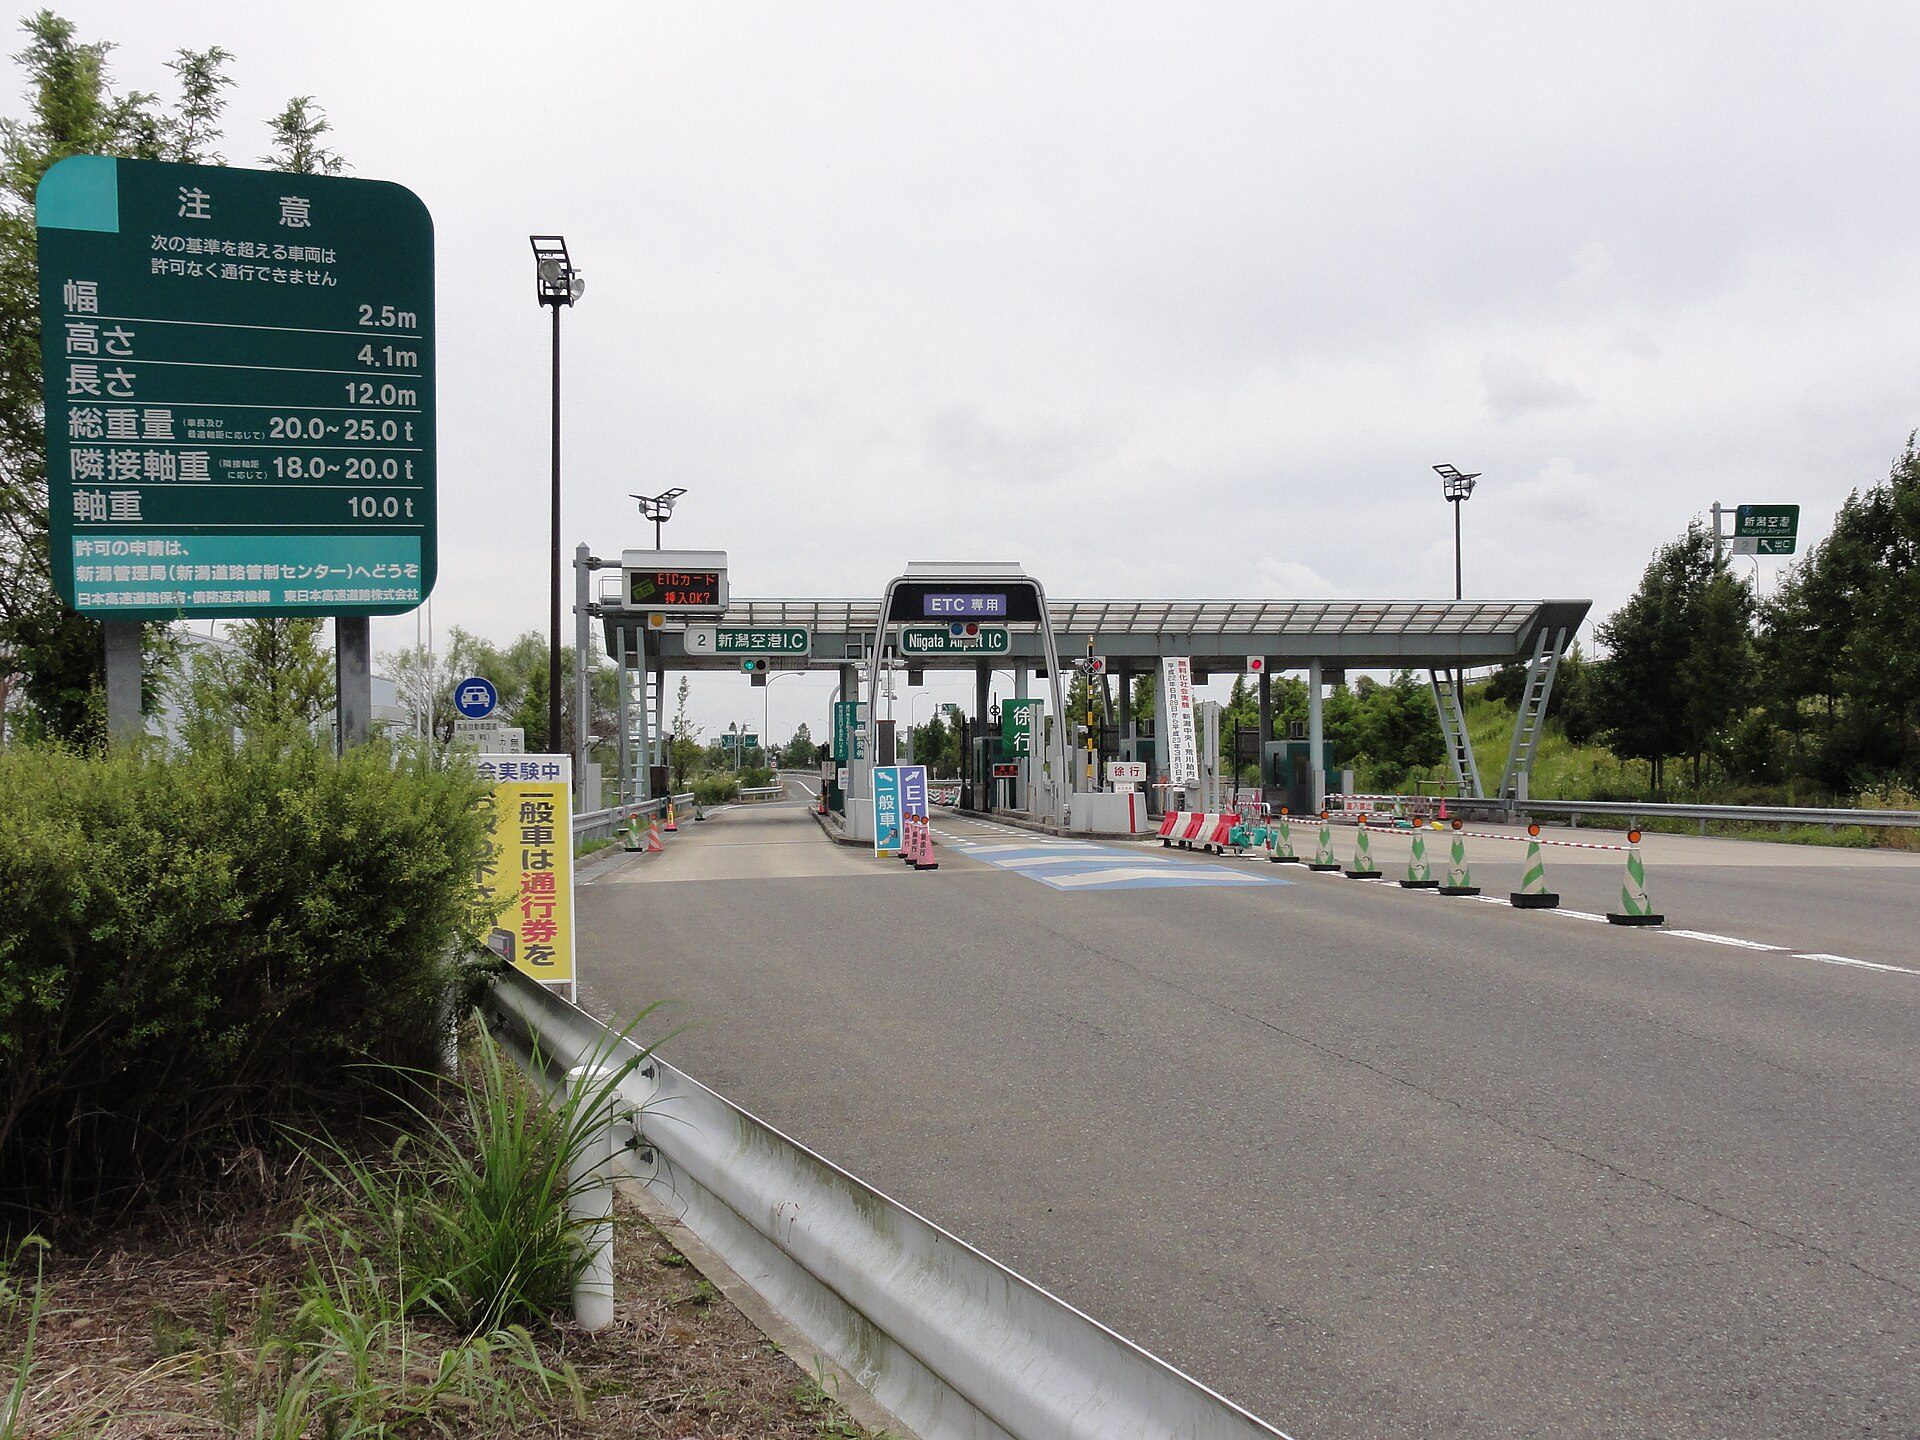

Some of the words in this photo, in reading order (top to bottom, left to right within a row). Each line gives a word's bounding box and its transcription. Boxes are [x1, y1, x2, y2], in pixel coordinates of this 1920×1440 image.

[151, 234, 337, 264] 次の基準を超える車両は
[151, 257, 337, 287] 許可なく通行できません
[63, 278, 98, 314] 幅
[358, 304, 417, 328] 2.5m
[65, 322, 136, 357] 高さ
[357, 344, 417, 367] 4.1m
[66, 363, 137, 397] 長さ
[345, 382, 417, 406] 12.0m
[68, 407, 175, 440] 総重量
[70, 448, 212, 482] 隣接軸重
[72, 489, 143, 521] 軸重
[1744, 516, 1790, 527] 新潟空港
[75, 540, 190, 556] 許可の申請は、
[1774, 540, 1791, 548] 出口
[656, 573, 716, 586] ETCカード
[283, 588, 419, 602] 東日本高速道路株式会社
[664, 591, 711, 604] 挿入OK?
[931, 598, 965, 611] ETC
[970, 598, 998, 611] 専用
[697, 633, 707, 647] 2
[909, 633, 944, 651] Niigata
[1013, 706, 1030, 751] 徐行
[1113, 765, 1140, 777] 徐行
[878, 787, 896, 827] 一般車
[906, 785, 922, 821] ET
[519, 792, 558, 967] 一般車は通行券を
